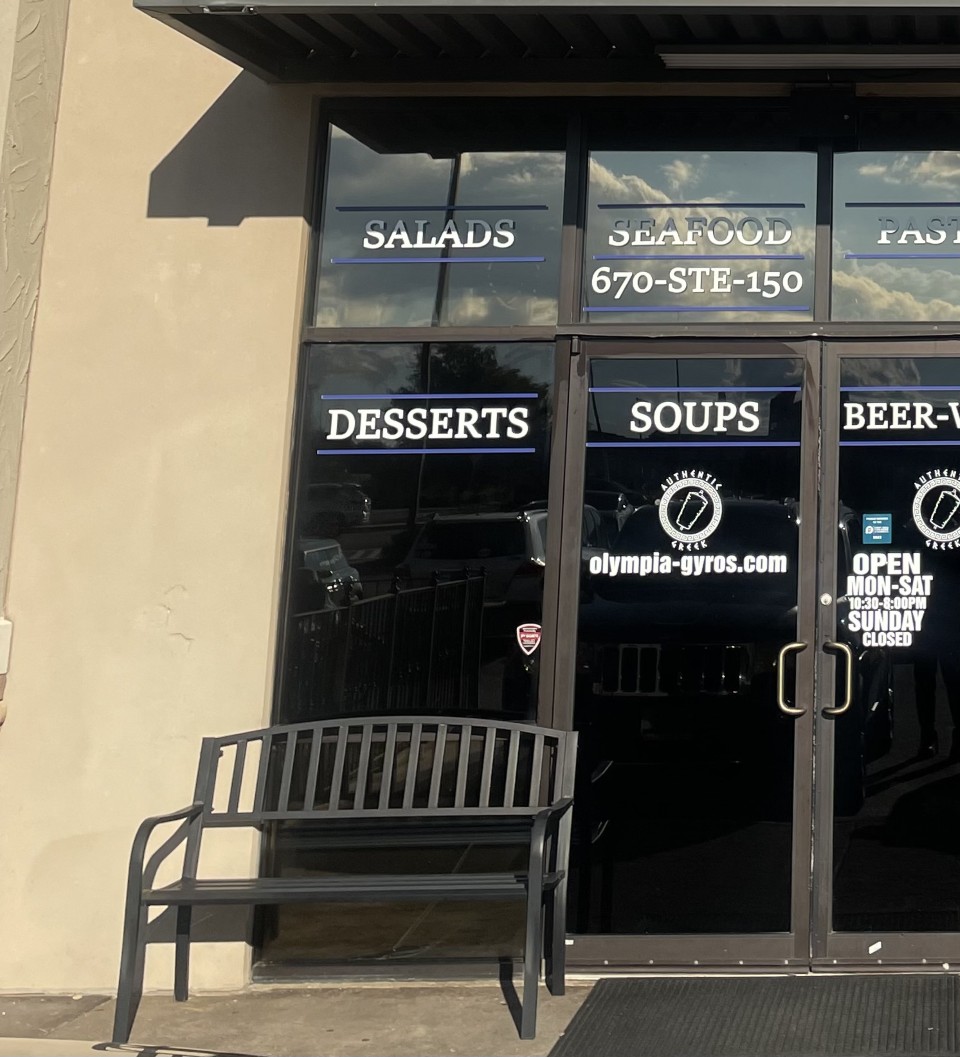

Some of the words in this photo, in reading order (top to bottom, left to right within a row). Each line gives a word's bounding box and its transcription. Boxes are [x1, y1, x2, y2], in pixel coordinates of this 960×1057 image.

[363, 218, 517, 250] SALADS
[608, 216, 793, 248] SEAFOOD
[591, 266, 804, 300] 670-STE-150
[326, 407, 530, 441] DESSERTS
[629, 401, 760, 434] SOUPS
[660, 469, 723, 492] AUTHENTIC
[671, 539, 708, 551] GREEK
[589, 551, 788, 576] olympia-gyros.com
[852, 552, 921, 575] OPEN
[846, 575, 934, 596] MON-SAT
[848, 596, 927, 610] 10:30-8:00PM
[848, 610, 925, 632] SUNDAY
[862, 631, 912, 647] CLOSED
